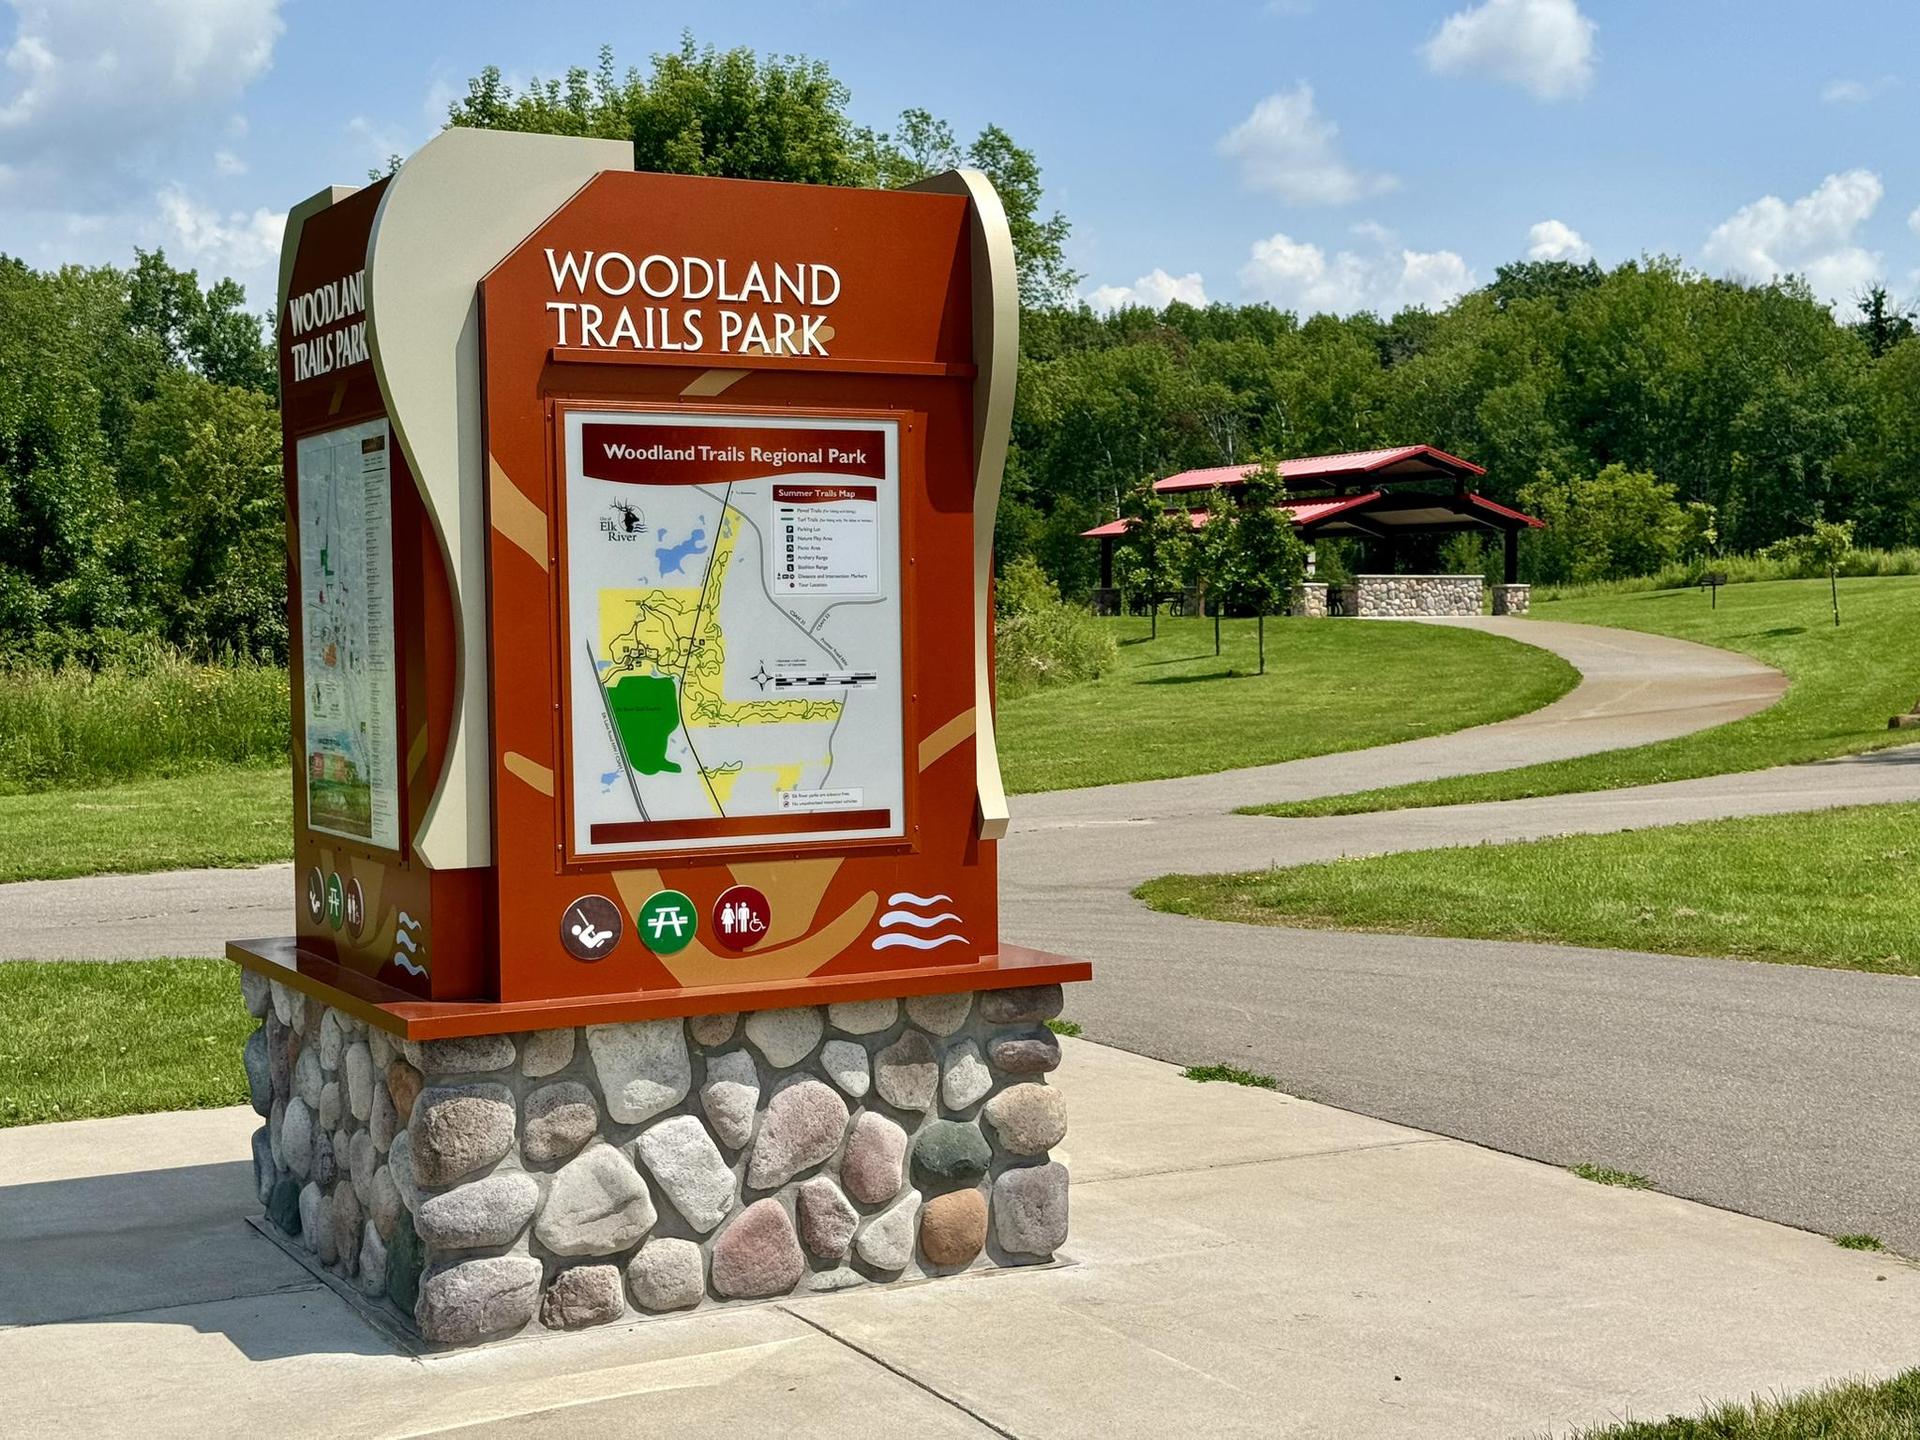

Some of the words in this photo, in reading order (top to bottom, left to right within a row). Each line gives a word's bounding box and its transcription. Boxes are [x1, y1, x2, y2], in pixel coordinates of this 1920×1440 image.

[544, 248, 841, 306] WOODLAND
[546, 302, 703, 351] TRAILS
[719, 310, 830, 356] PARK
[291, 333, 333, 382] TRAILS
[335, 320, 370, 369] PARK
[603, 443, 695, 461] Woodland
[698, 445, 745, 462] Trails
[750, 447, 823, 466] Regional
[828, 448, 866, 464] Park
[778, 489, 813, 497] Summer
[814, 489, 837, 497] Trails
[838, 489, 856, 498] Map
[600, 521, 617, 531] Elk
[608, 531, 637, 541] River
